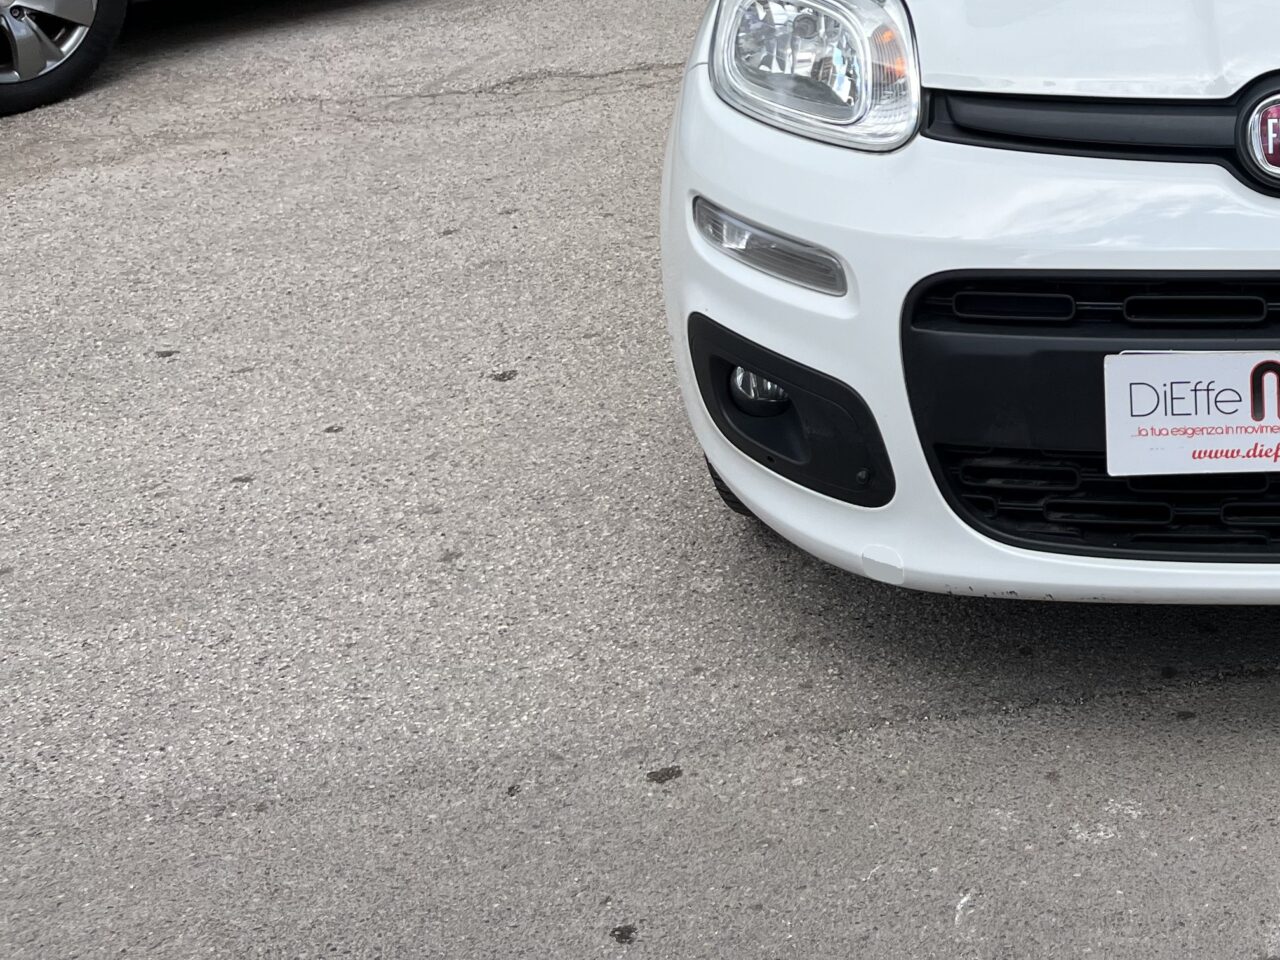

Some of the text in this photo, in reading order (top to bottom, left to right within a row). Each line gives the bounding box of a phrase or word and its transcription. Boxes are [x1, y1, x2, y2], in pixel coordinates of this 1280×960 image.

[1129, 380, 1242, 417] DiEffe
[1151, 427, 1169, 437] tua
[1171, 425, 1224, 438] esigenza
[1225, 425, 1234, 434] in
